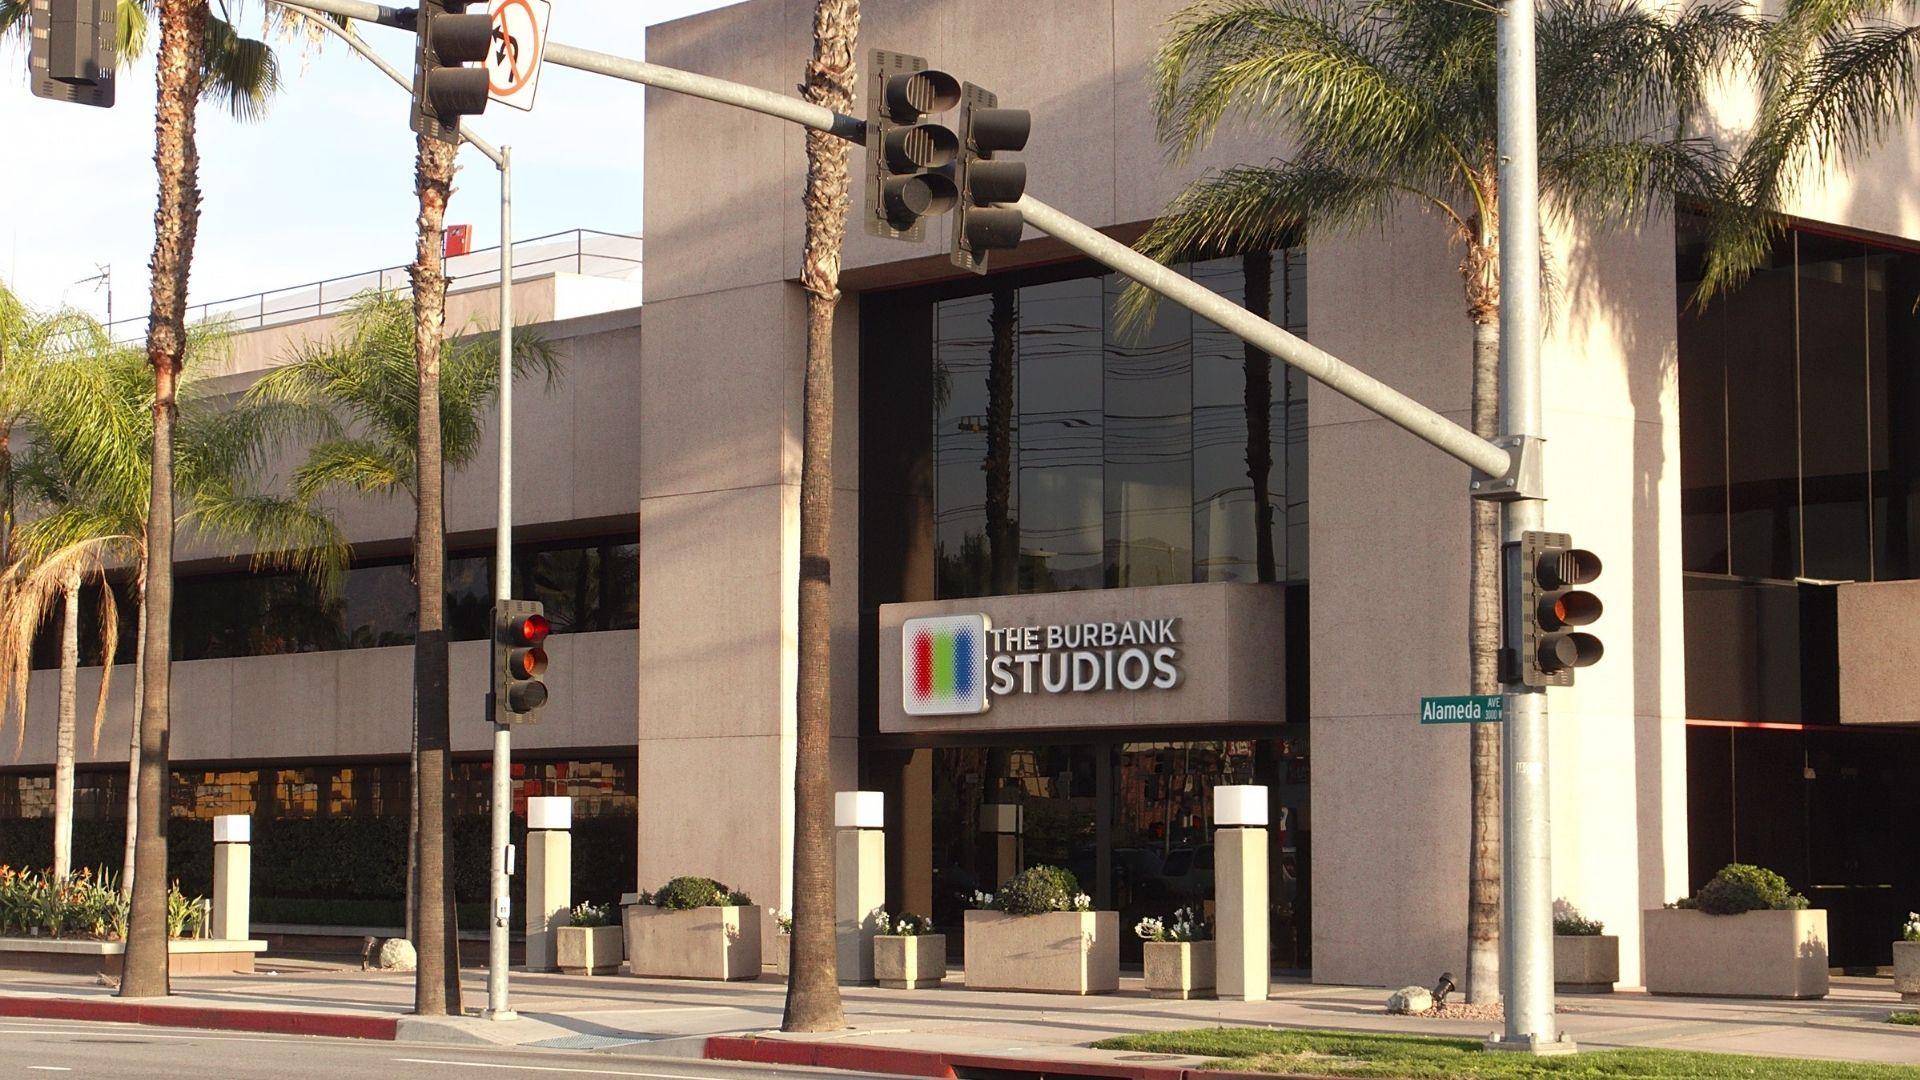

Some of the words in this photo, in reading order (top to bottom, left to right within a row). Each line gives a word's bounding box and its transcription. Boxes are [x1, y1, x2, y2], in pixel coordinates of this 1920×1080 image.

[990, 626, 1040, 652] THE
[1046, 618, 1177, 650] BURBANK
[990, 647, 1178, 695] STUDIOS
[1423, 700, 1481, 720] Alameda
[1487, 697, 1501, 708] AVE
